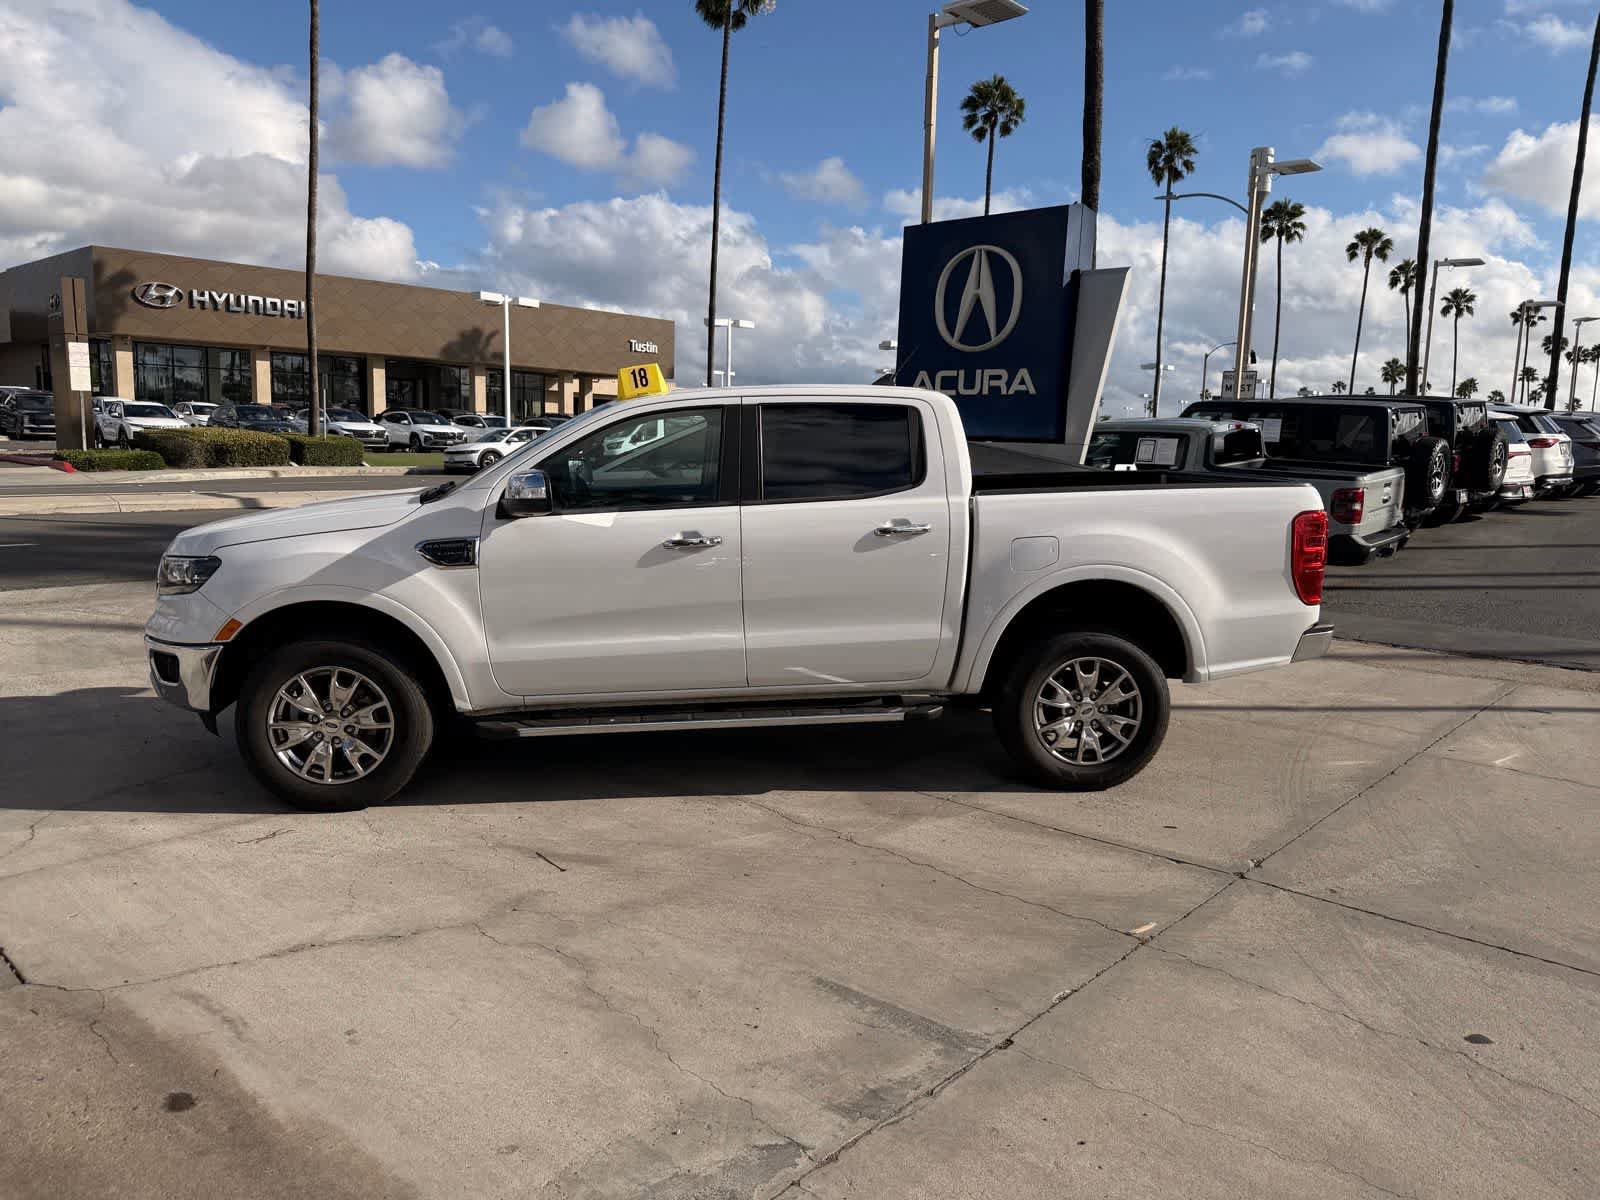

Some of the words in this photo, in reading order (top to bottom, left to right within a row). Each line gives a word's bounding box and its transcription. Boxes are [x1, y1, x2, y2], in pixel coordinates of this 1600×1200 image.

[191, 288, 305, 317] HYUNDAI
[629, 339, 658, 353] Tustin
[630, 367, 649, 389] 18
[912, 367, 1037, 395] ACURA
[1225, 384, 1251, 392] MST
